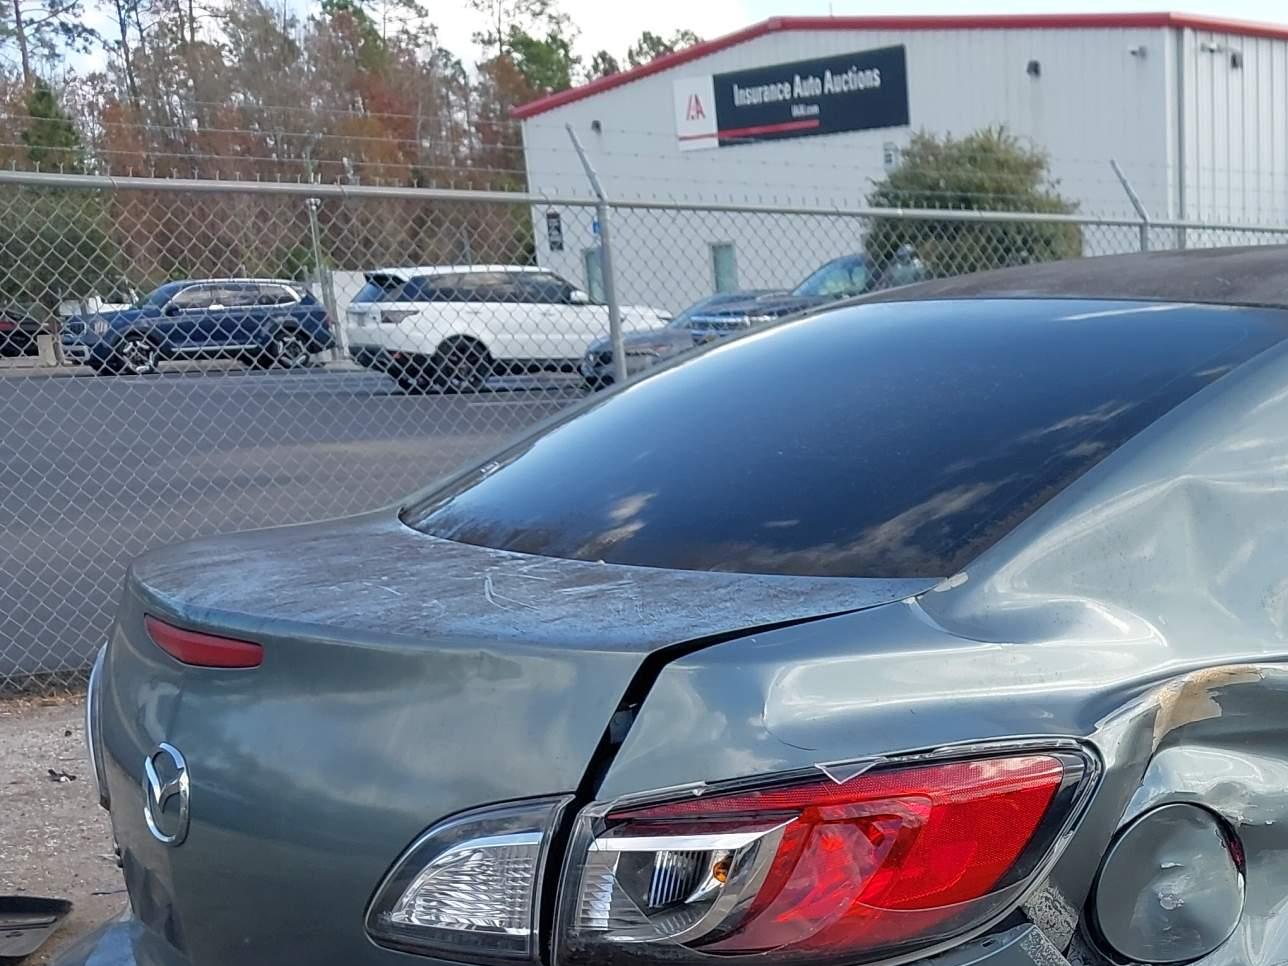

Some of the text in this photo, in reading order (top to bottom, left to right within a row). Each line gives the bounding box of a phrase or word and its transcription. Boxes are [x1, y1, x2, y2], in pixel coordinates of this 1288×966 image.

[732, 64, 881, 107] Insurance Auto Auctions
